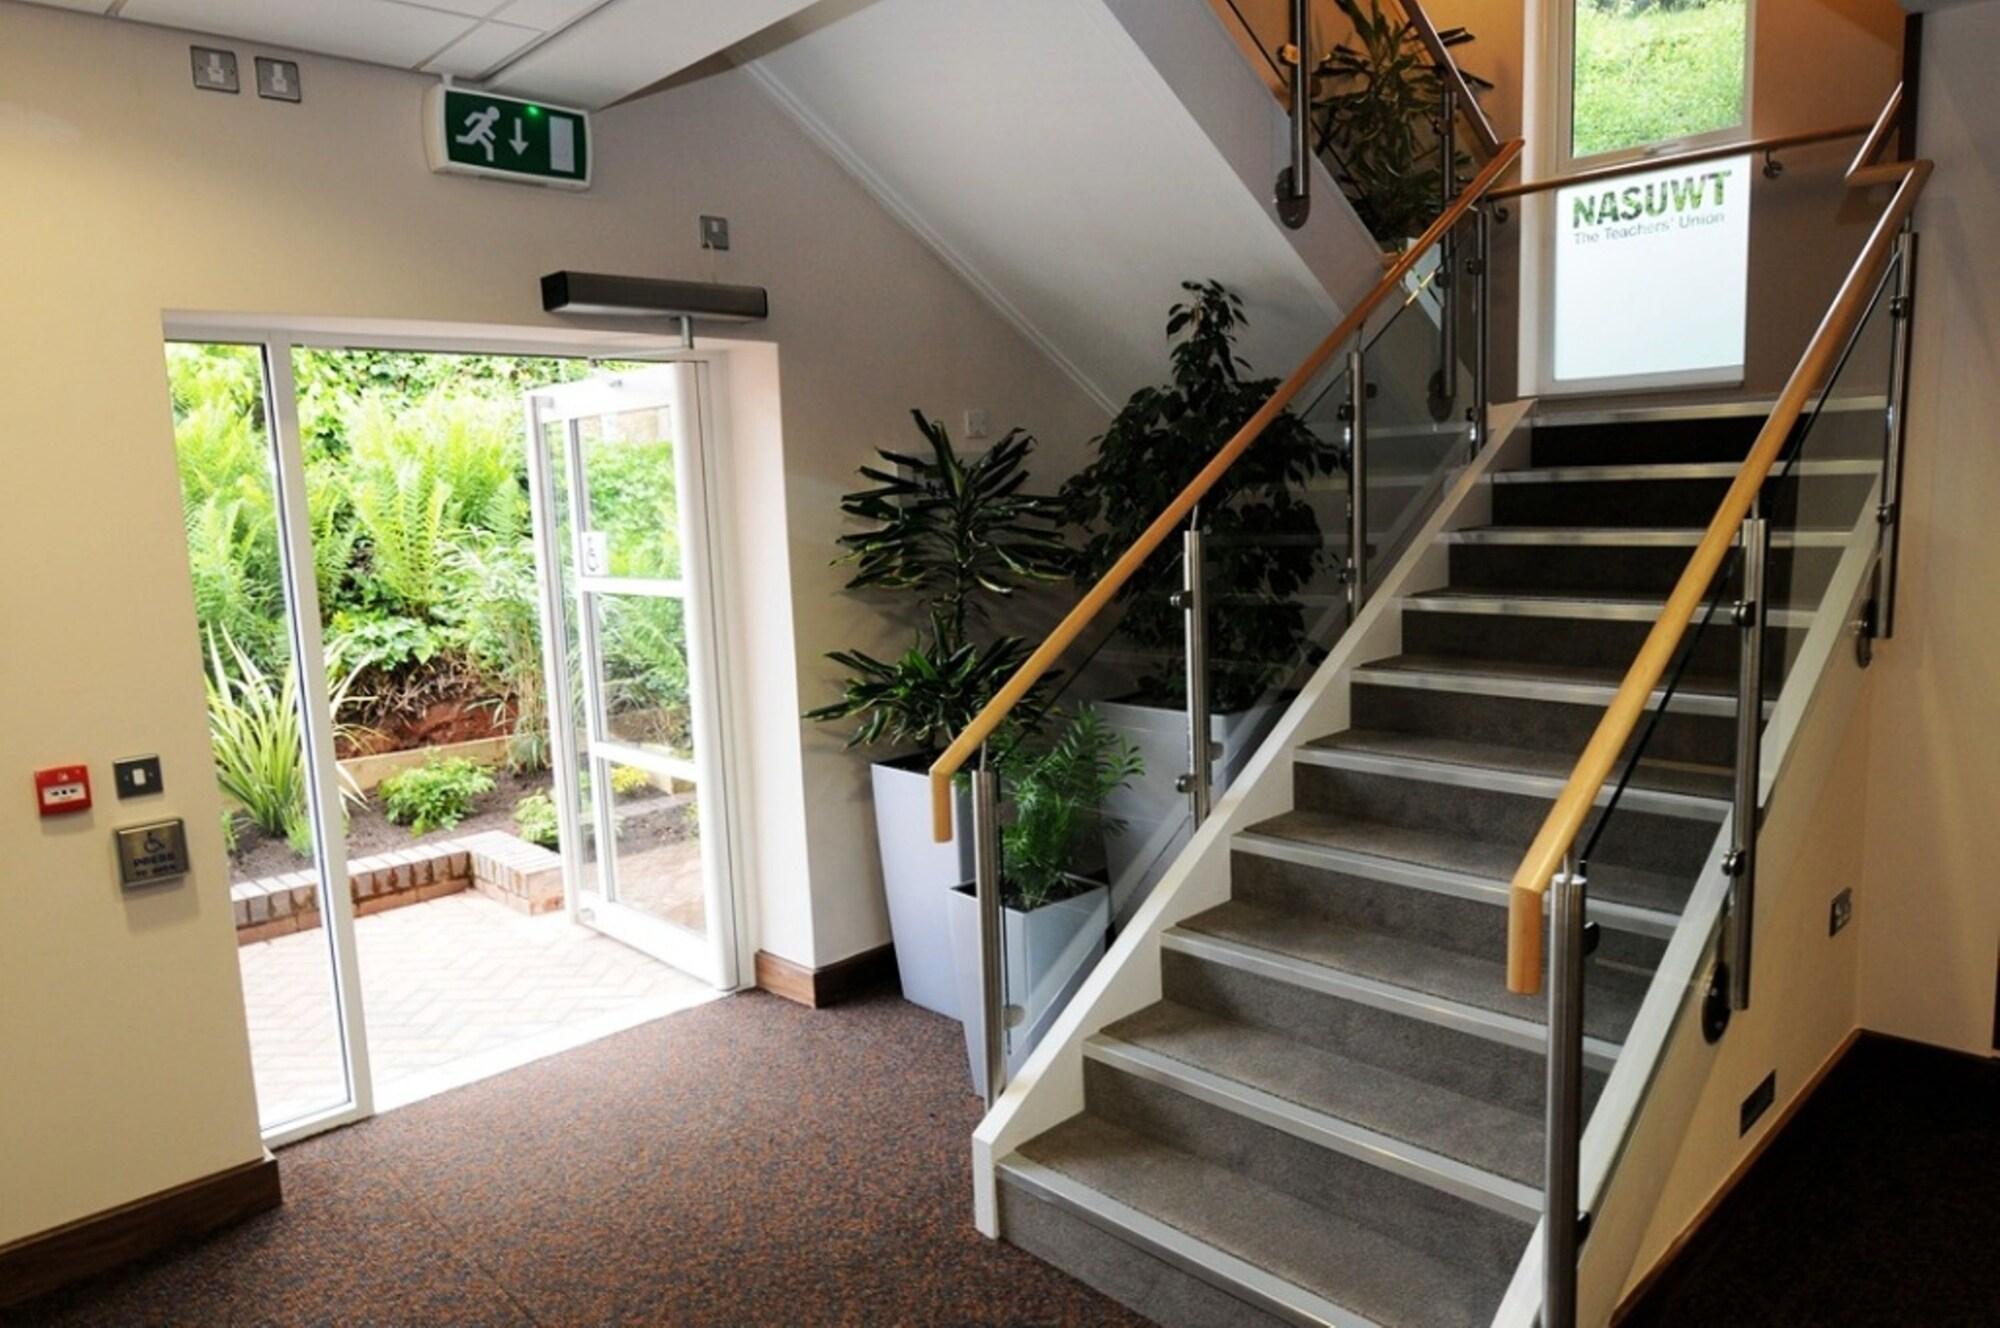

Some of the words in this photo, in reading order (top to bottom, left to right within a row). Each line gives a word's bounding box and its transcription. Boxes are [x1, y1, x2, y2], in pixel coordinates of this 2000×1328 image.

[1573, 170, 1732, 229] NASUWT
[1574, 231, 1600, 245] The
[1604, 217, 1675, 241] Teachers'
[1679, 211, 1726, 229] Union
